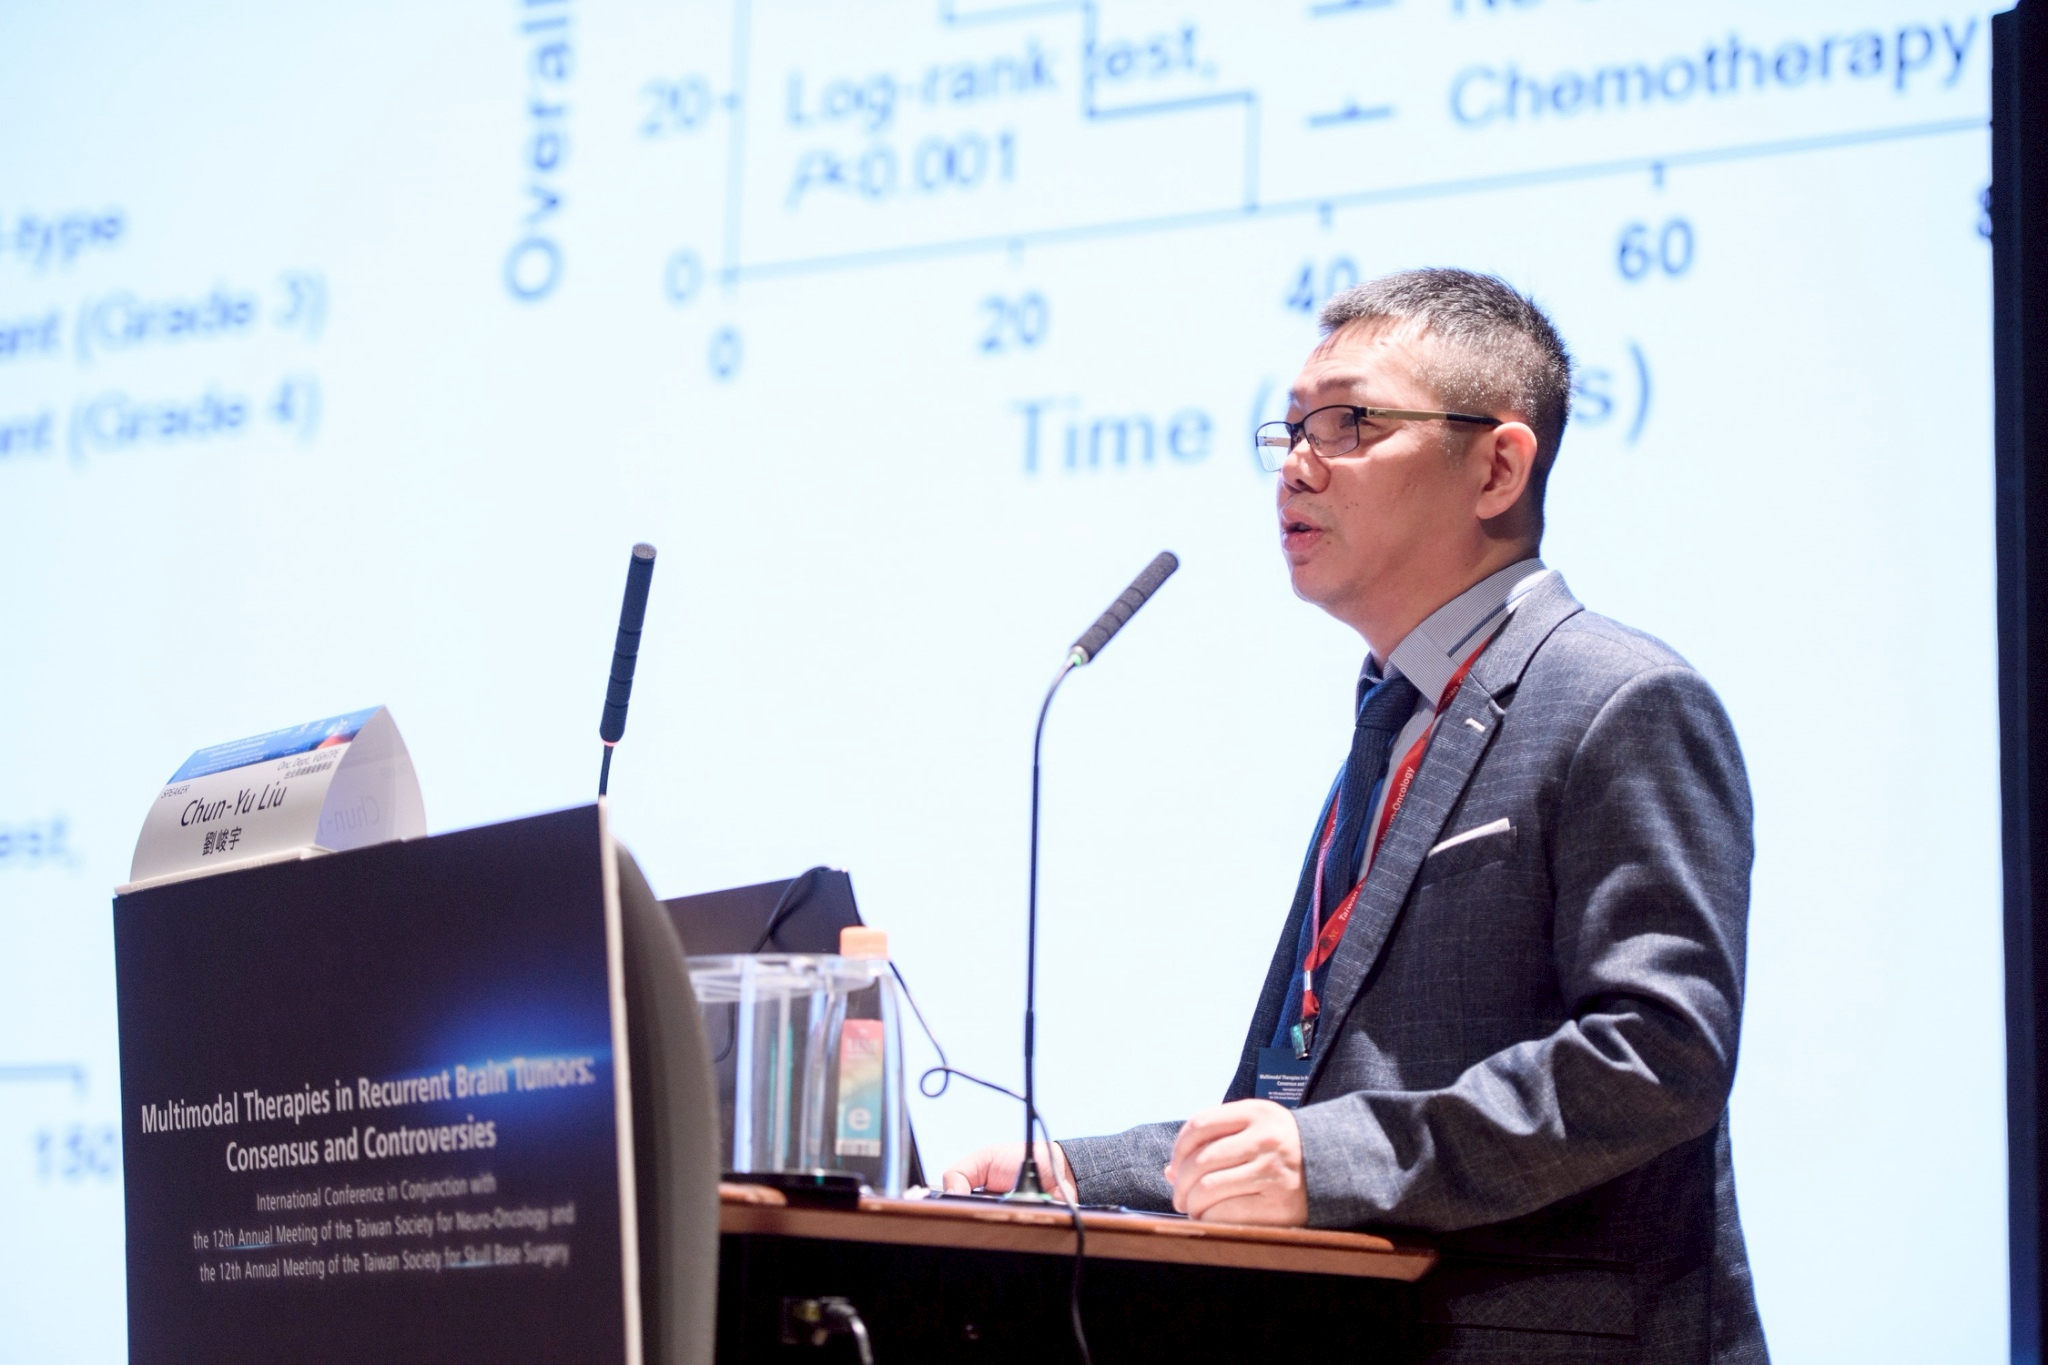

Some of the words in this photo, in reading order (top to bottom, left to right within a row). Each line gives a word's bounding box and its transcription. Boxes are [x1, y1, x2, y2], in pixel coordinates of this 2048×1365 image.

[786, 36, 1056, 135] Log-rank
[1450, 16, 1978, 130] Chemotherapy
[639, 74, 708, 138] 20
[665, 247, 704, 304] 0
[1617, 219, 1694, 281] 60
[1284, 252, 1360, 312] 40
[978, 291, 1049, 355] 20
[708, 325, 743, 383] 0
[1011, 395, 1213, 474] Time
[161, 785, 190, 799] SPEAKER
[180, 787, 257, 827] Chun-Yu
[258, 781, 288, 811] Liu
[202, 826, 242, 856] 劉峻宇
[1338, 891, 1359, 920] Taiwan
[141, 1091, 239, 1133] Multimodal
[243, 1082, 330, 1125] Therapies
[335, 1079, 353, 1112] in
[358, 1070, 451, 1109] Recurrent
[455, 1059, 508, 1098] Brain
[512, 1056, 596, 1091] Tumors:
[226, 1141, 319, 1172] Consensus
[324, 1126, 359, 1162] and
[364, 1114, 497, 1159] Controversies
[256, 1186, 321, 1212] International
[324, 1184, 384, 1206] Conference
[387, 1181, 398, 1200] in
[401, 1177, 469, 1203] Conjunction
[470, 1172, 497, 1194] with
[193, 1231, 209, 1249] the
[213, 1228, 235, 1248] 12th
[238, 1226, 273, 1246] Annual
[276, 1223, 318, 1246] Meeting
[321, 1220, 333, 1240] of
[335, 1219, 352, 1239] the
[355, 1218, 392, 1238] Taiwan
[394, 1214, 434, 1238] Society
[436, 1211, 453, 1232] for
[455, 1206, 549, 1231] Neuro-Oncology
[551, 1202, 575, 1224] and
[200, 1263, 216, 1282] the
[219, 1260, 242, 1281] 12th
[245, 1258, 280, 1279] Annual
[283, 1257, 325, 1280] Meeting
[328, 1254, 340, 1274] of
[342, 1254, 359, 1273] the
[362, 1251, 399, 1271] Taiwan
[402, 1249, 441, 1273] Society
[444, 1245, 461, 1266] for
[494, 1243, 521, 1265] Base
[523, 1241, 570, 1269] Surgery
